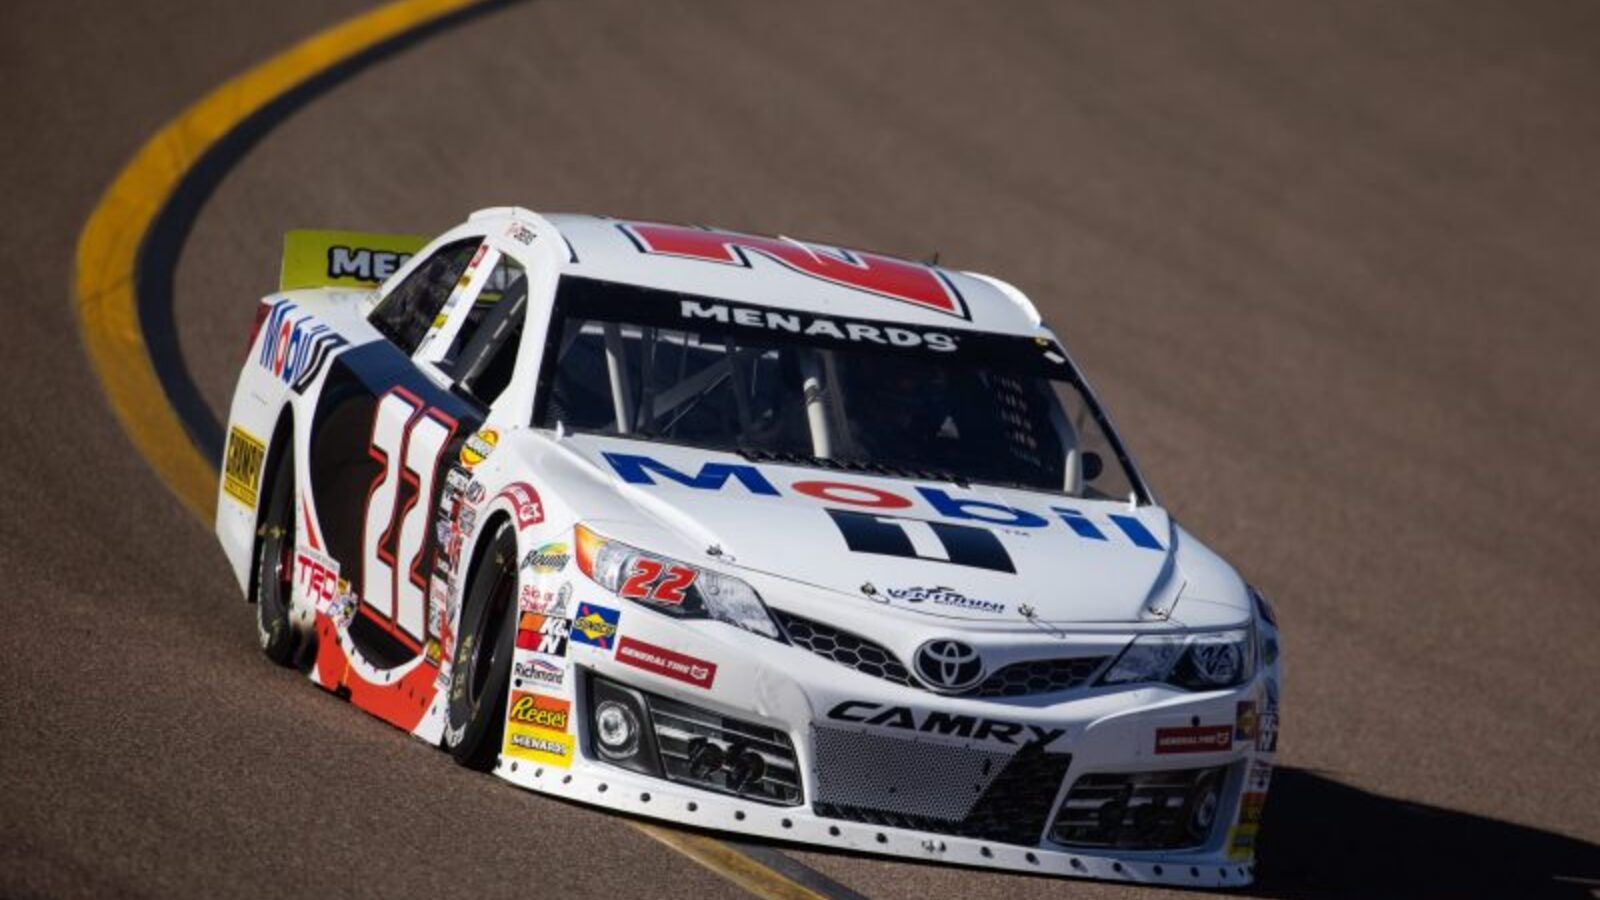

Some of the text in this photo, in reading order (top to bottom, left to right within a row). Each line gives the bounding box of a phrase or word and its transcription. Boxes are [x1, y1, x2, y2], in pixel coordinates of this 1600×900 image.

[679, 299, 957, 353] MENARDS
[601, 452, 1165, 551] Mobil
[297, 553, 337, 605] TRD
[619, 557, 700, 604] 22
[620, 646, 667, 667] GENERAL
[827, 700, 1067, 748] CAMRY
